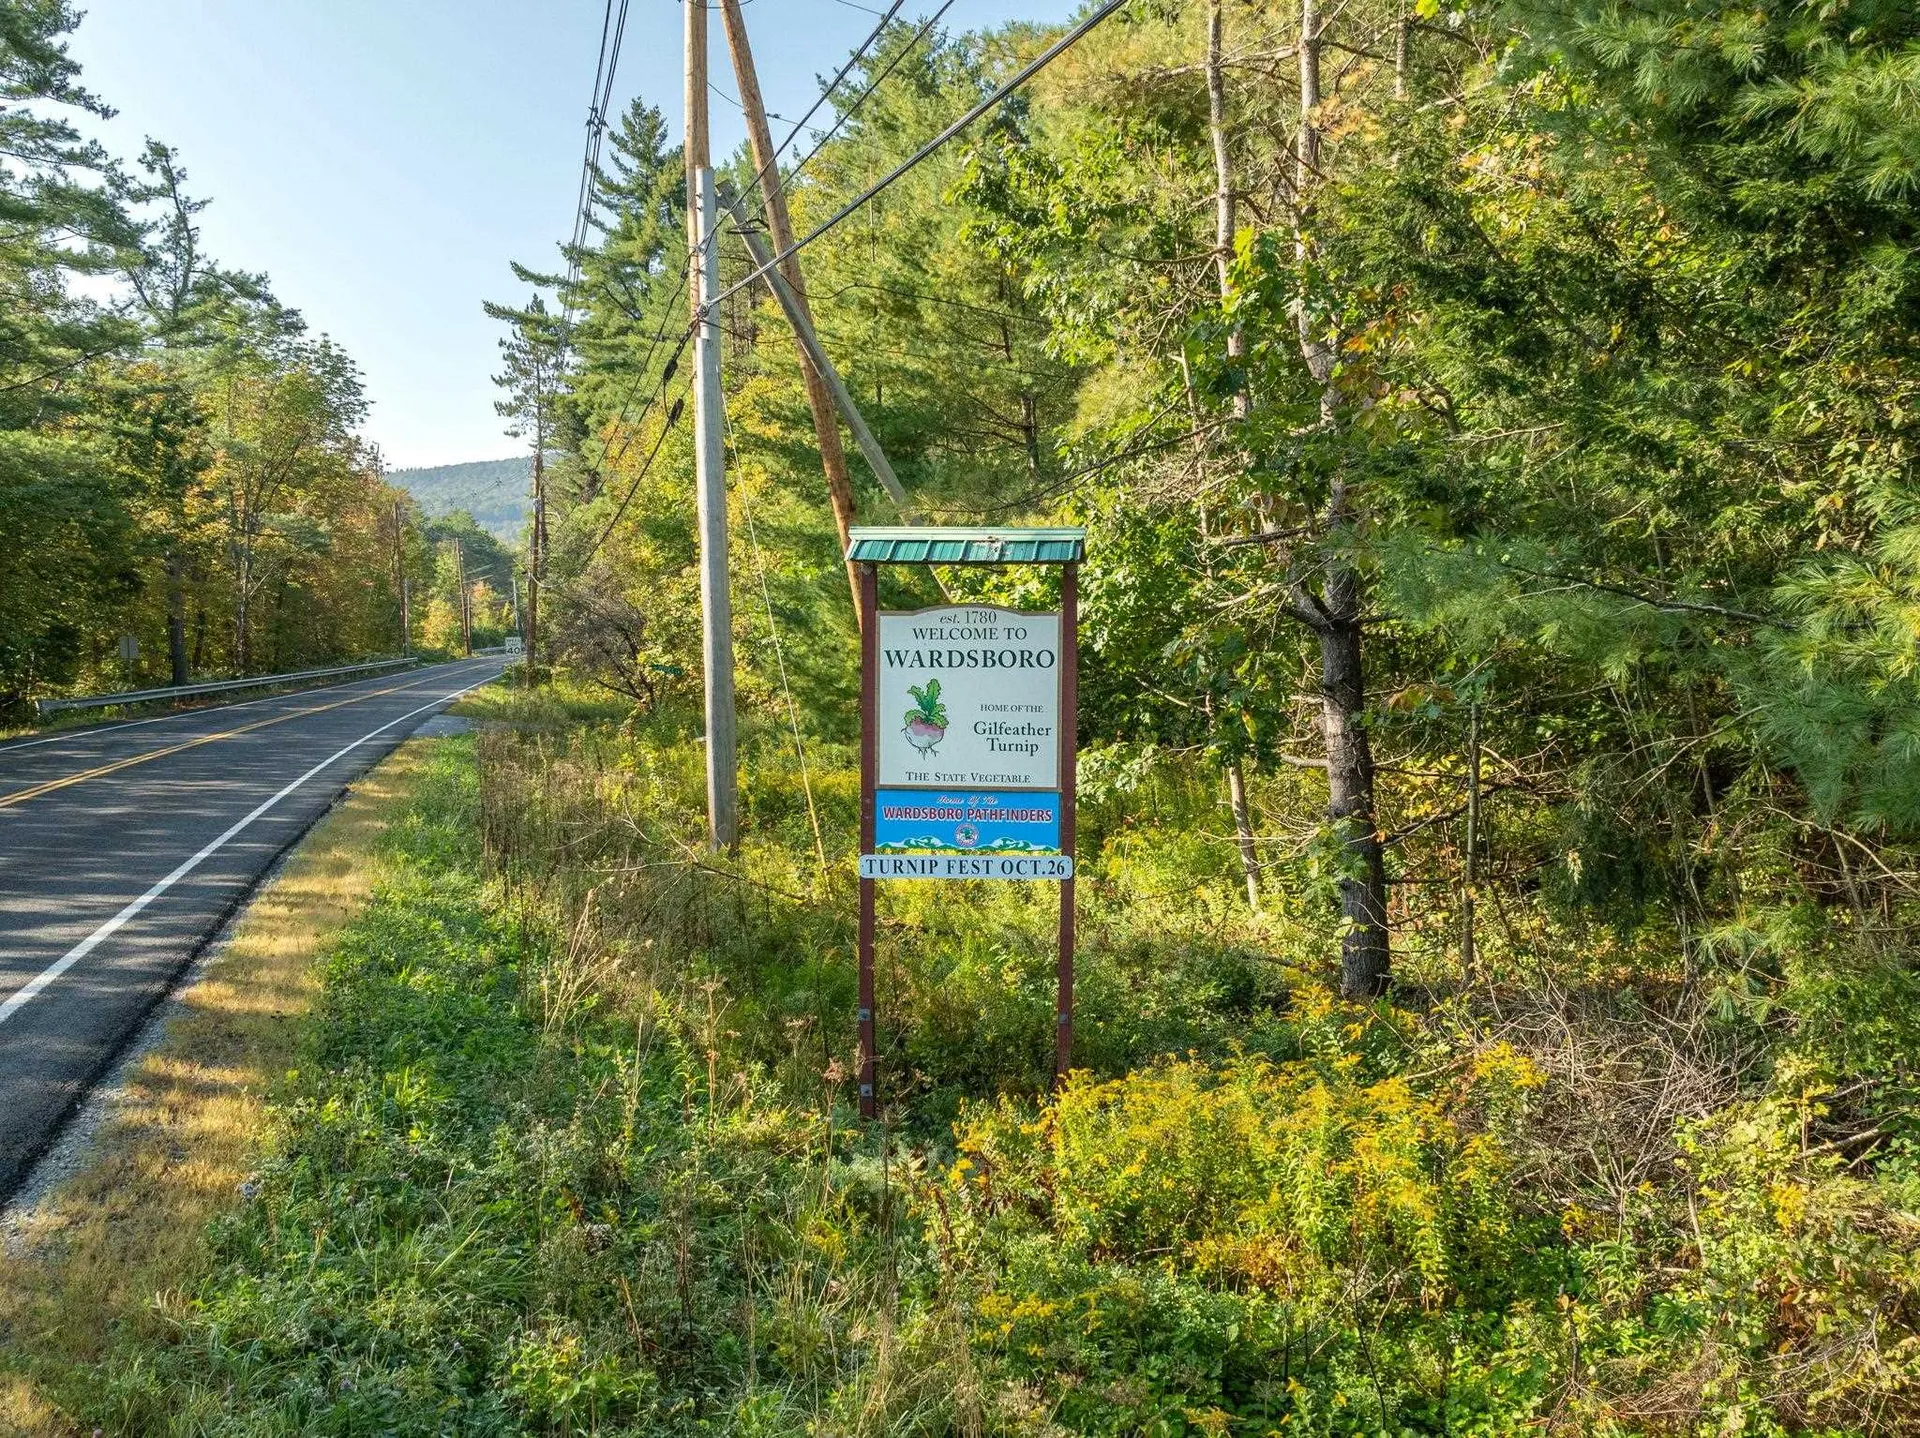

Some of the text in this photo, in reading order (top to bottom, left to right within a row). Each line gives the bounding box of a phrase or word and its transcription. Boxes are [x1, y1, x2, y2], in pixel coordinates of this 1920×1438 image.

[939, 610, 997, 624] est. 1780
[912, 627, 1027, 641] WELCOME TO
[507, 647, 520, 655] 40
[884, 649, 1055, 669] WARDSBORO
[980, 704, 1044, 713] HOME OF THE
[973, 721, 1052, 737] Gilfeather
[986, 737, 1039, 756] Turnip
[883, 807, 1052, 822] WARDSBORO PATHFINDERS
[865, 858, 1065, 876] TURNIP FEST OCT.26
